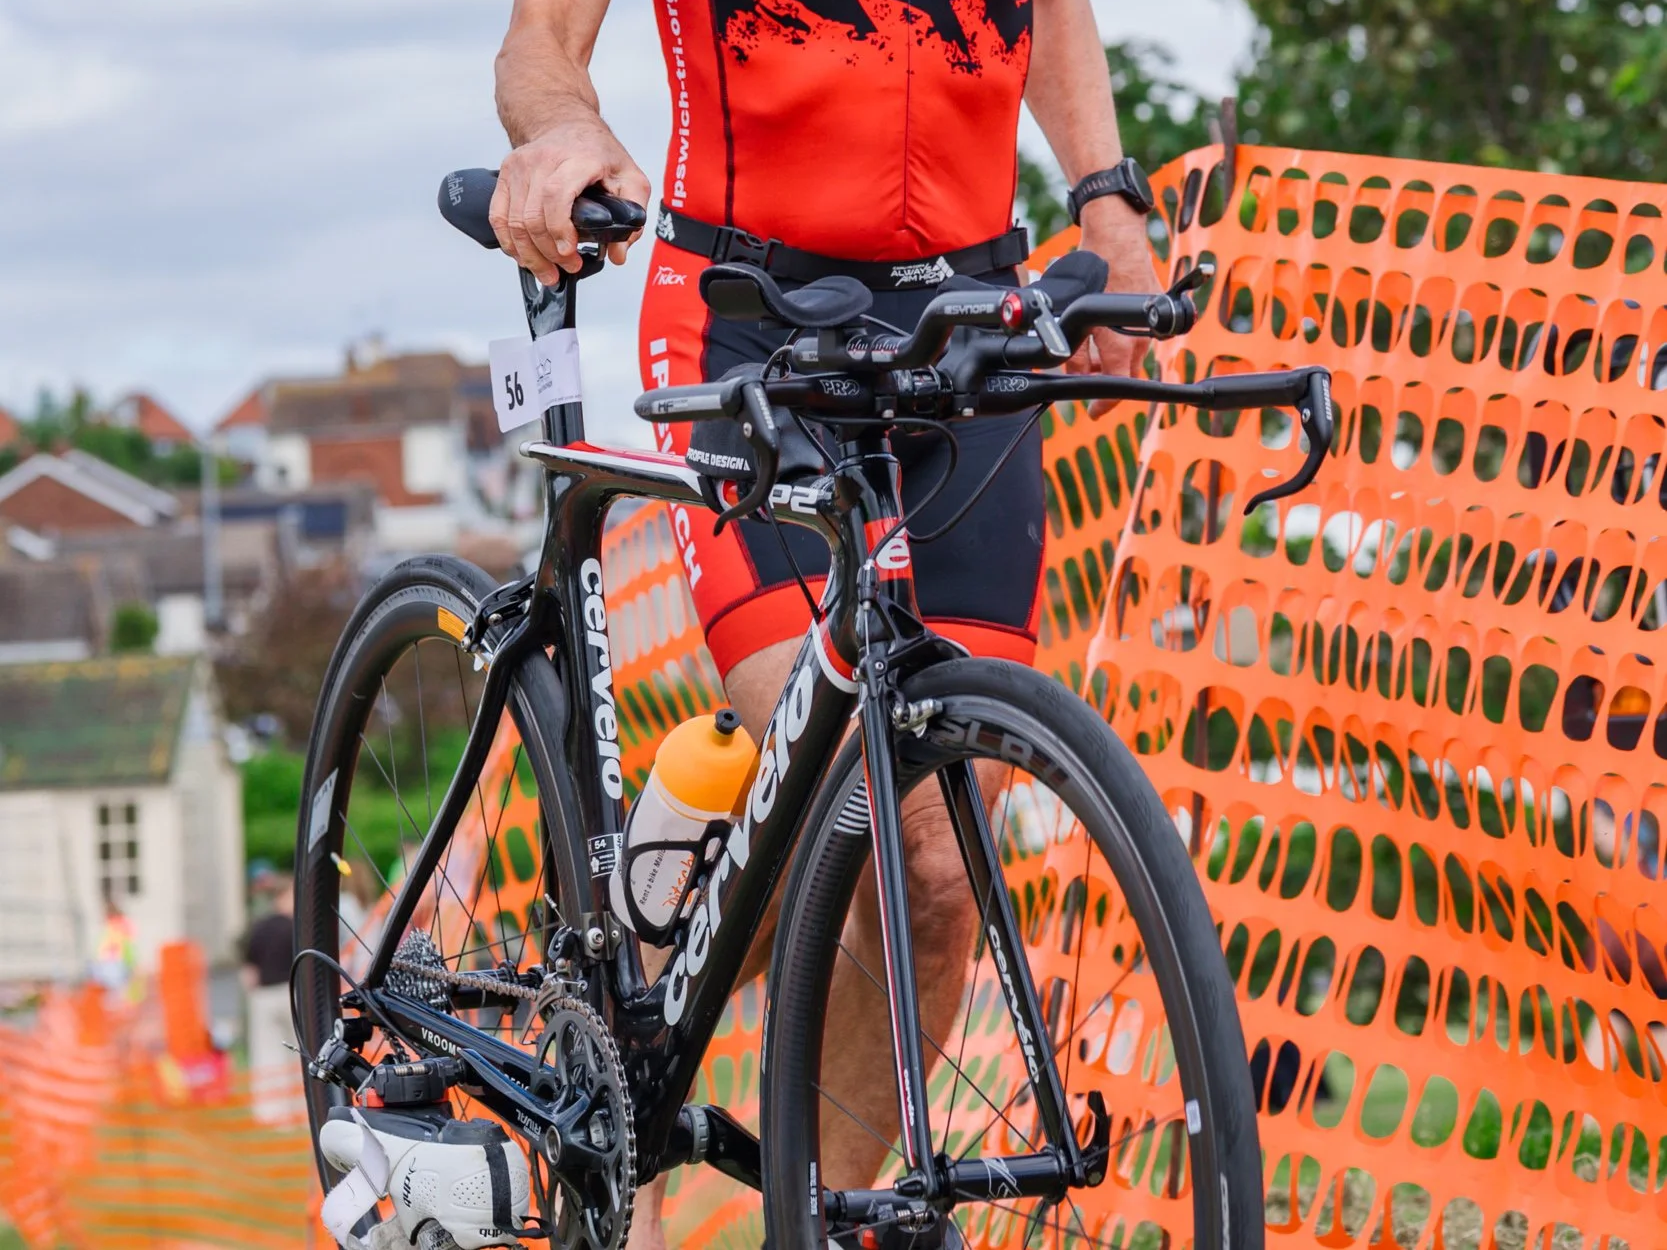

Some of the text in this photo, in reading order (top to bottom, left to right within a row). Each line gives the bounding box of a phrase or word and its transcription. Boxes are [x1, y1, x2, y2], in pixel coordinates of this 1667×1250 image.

[505, 371, 524, 411] 56
[819, 379, 860, 396] PRO
[986, 376, 1029, 392] PRO
[710, 452, 744, 470] DESIGN
[768, 484, 819, 515] P2
[594, 838, 607, 850] 54
[479, 1228, 503, 1238] dhb
